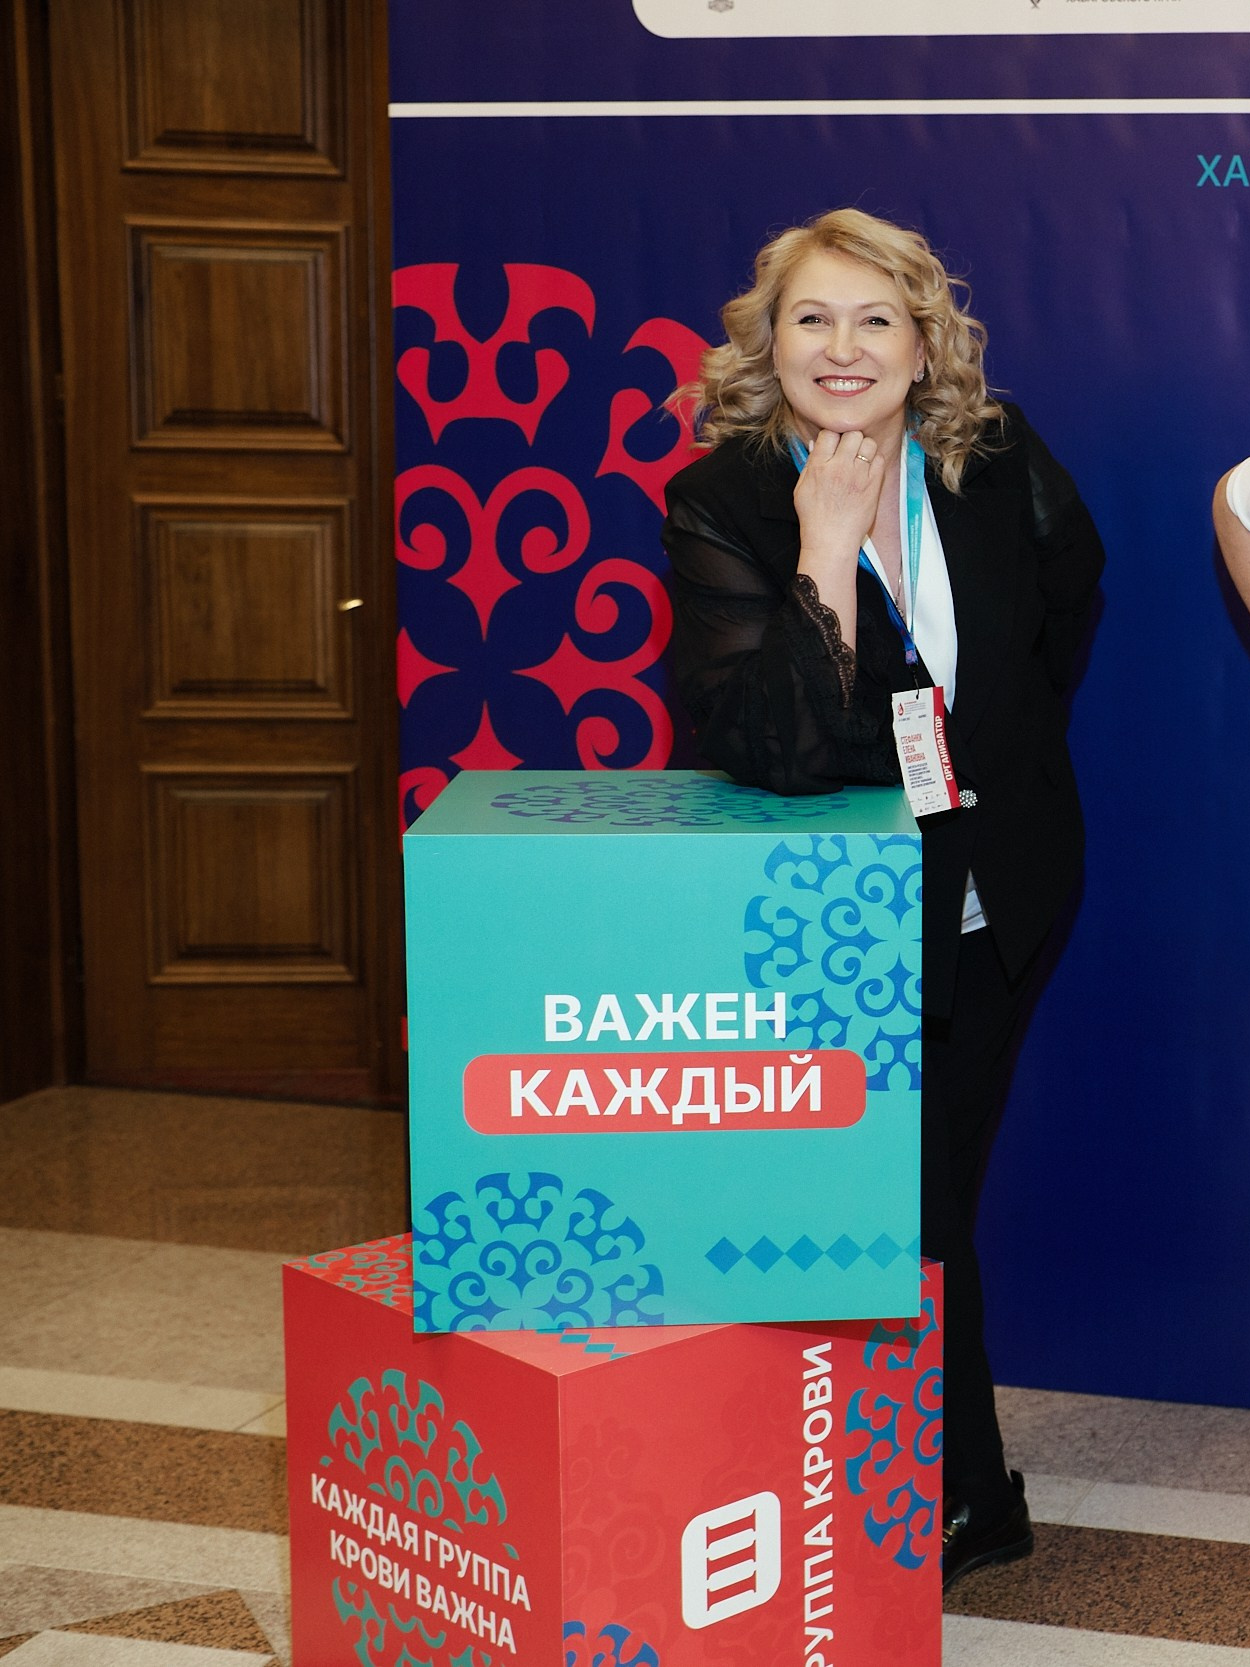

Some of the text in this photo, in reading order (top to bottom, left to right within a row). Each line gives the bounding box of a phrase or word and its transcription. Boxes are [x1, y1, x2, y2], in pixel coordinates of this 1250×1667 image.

[935, 716, 953, 781] ОРГАНИЗАТОР
[543, 991, 787, 1042] ВАЖЕН
[509, 1053, 822, 1125] КАЖДЫЙ
[802, 1341, 833, 1510] КРОВИ
[311, 1473, 532, 1612] КАЖДАЯ ГРУППА
[330, 1529, 517, 1655] КРОВИ ВАЖНА
